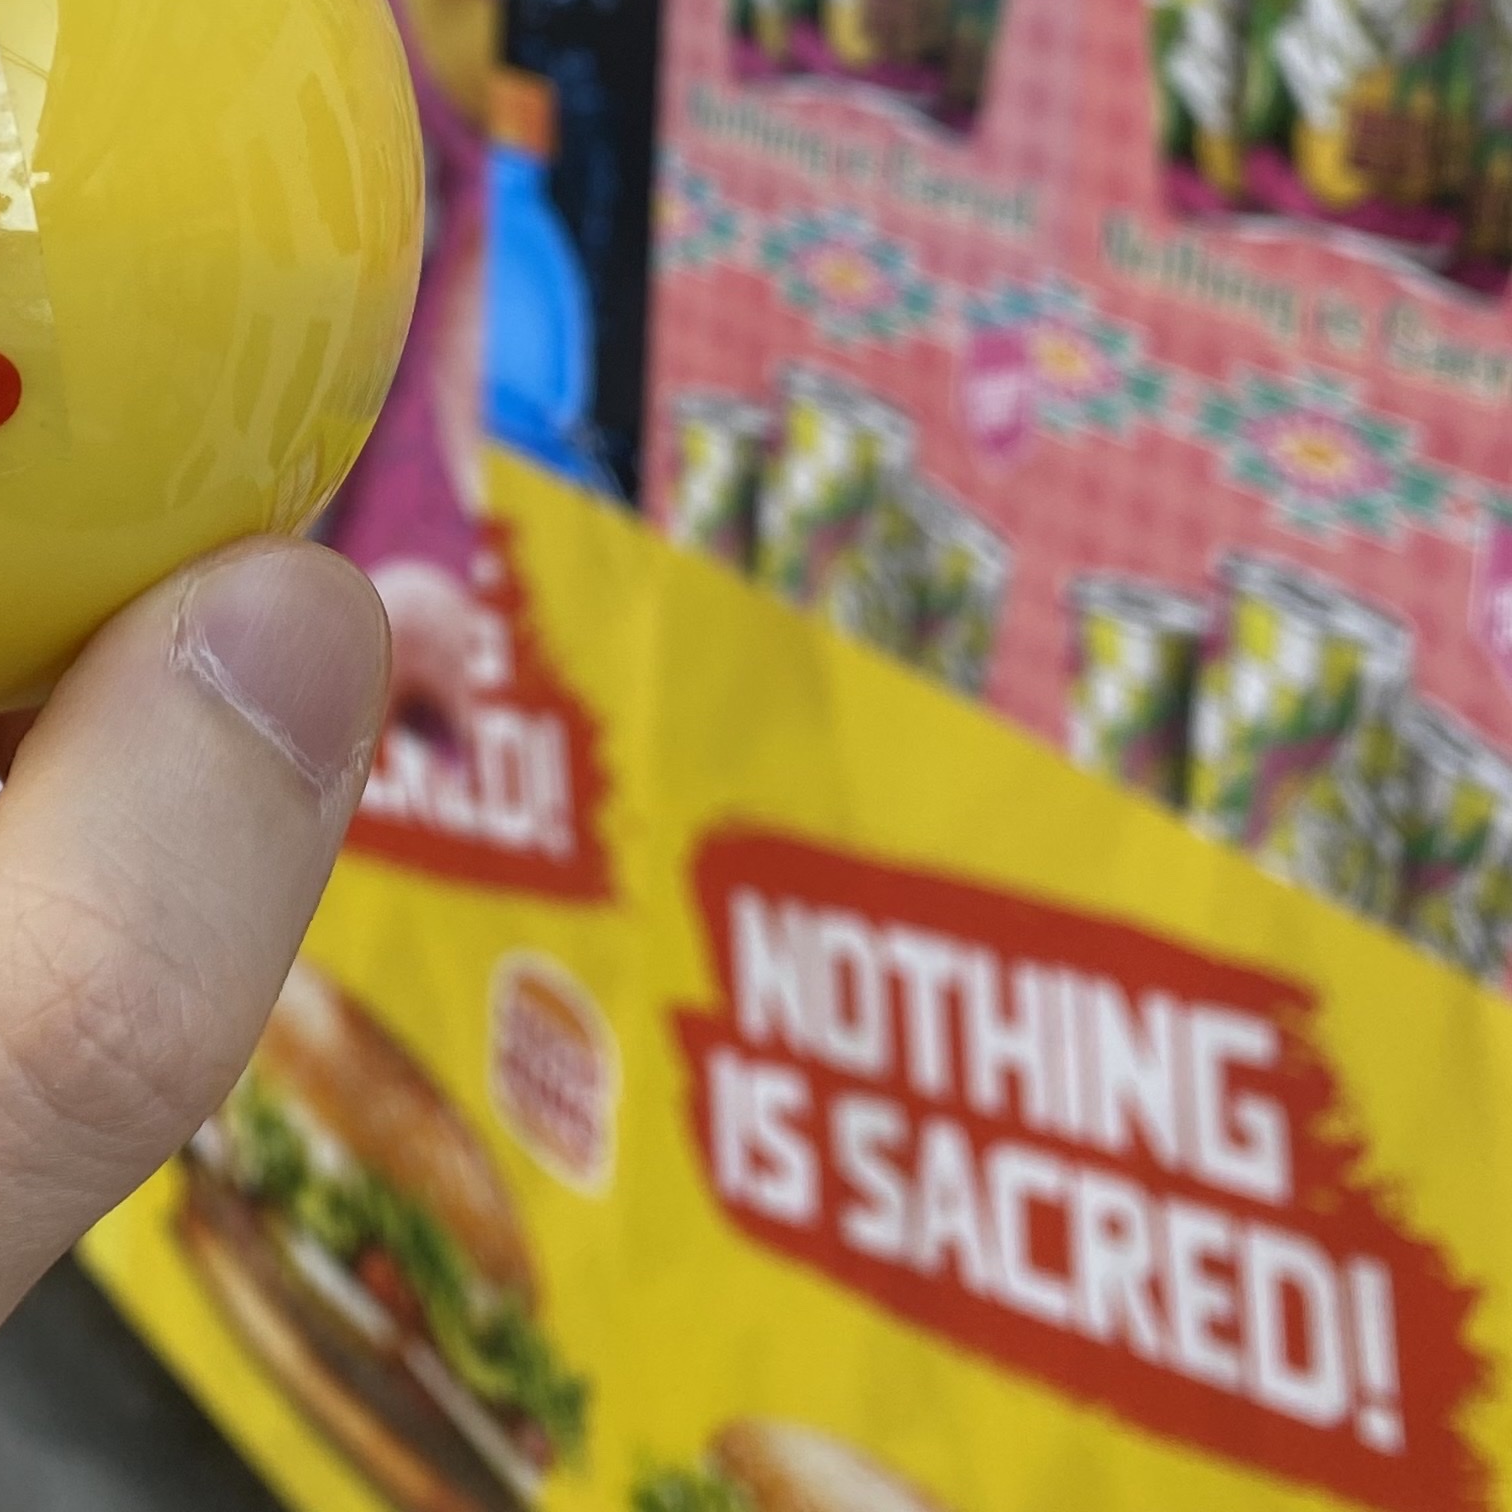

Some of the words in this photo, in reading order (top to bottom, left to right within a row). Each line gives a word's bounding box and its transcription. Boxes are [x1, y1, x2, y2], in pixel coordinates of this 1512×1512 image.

[726, 888, 1292, 1206] NOTHING
[708, 1044, 822, 1230] IS
[828, 1092, 1406, 1458] SACRED!
